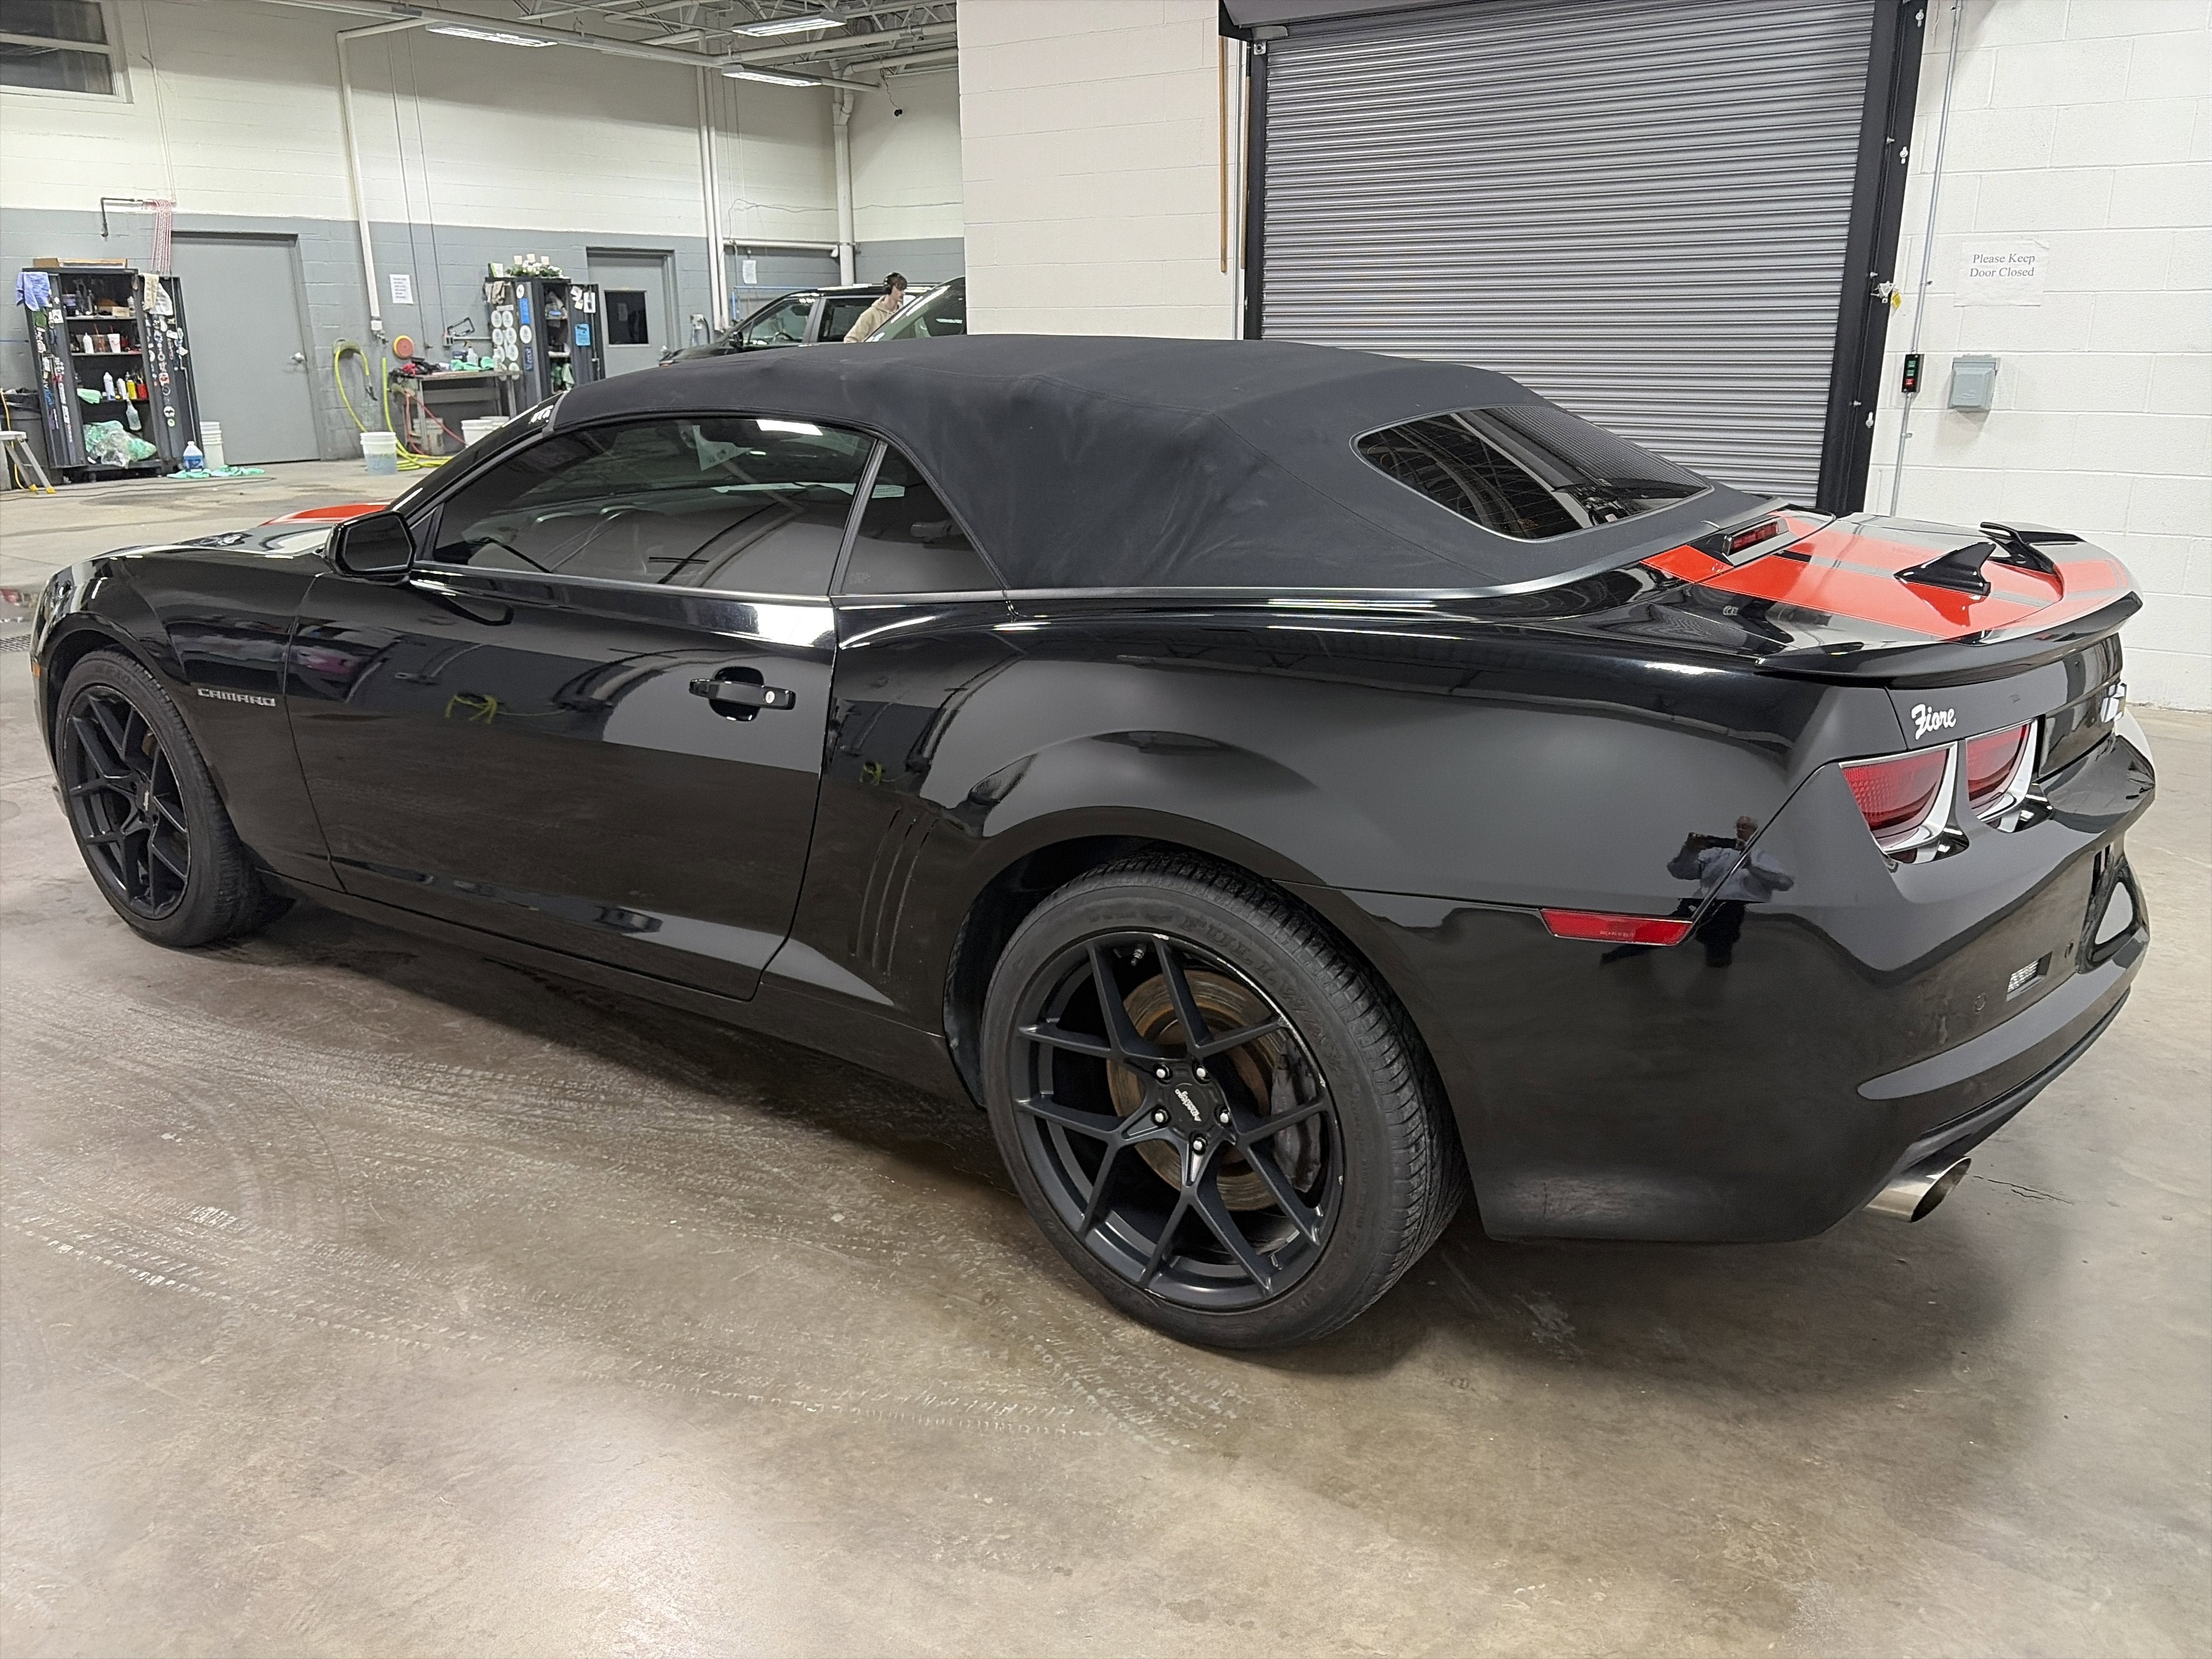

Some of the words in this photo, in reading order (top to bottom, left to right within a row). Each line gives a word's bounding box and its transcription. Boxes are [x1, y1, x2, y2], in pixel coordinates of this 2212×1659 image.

[1973, 254, 2005, 263] Please
[2008, 253, 2035, 264] Keep
[1970, 268, 1996, 277] Door
[1999, 267, 2034, 276] Closed
[198, 688, 276, 707] CAMARO
[1911, 704, 1956, 740] Fiore
